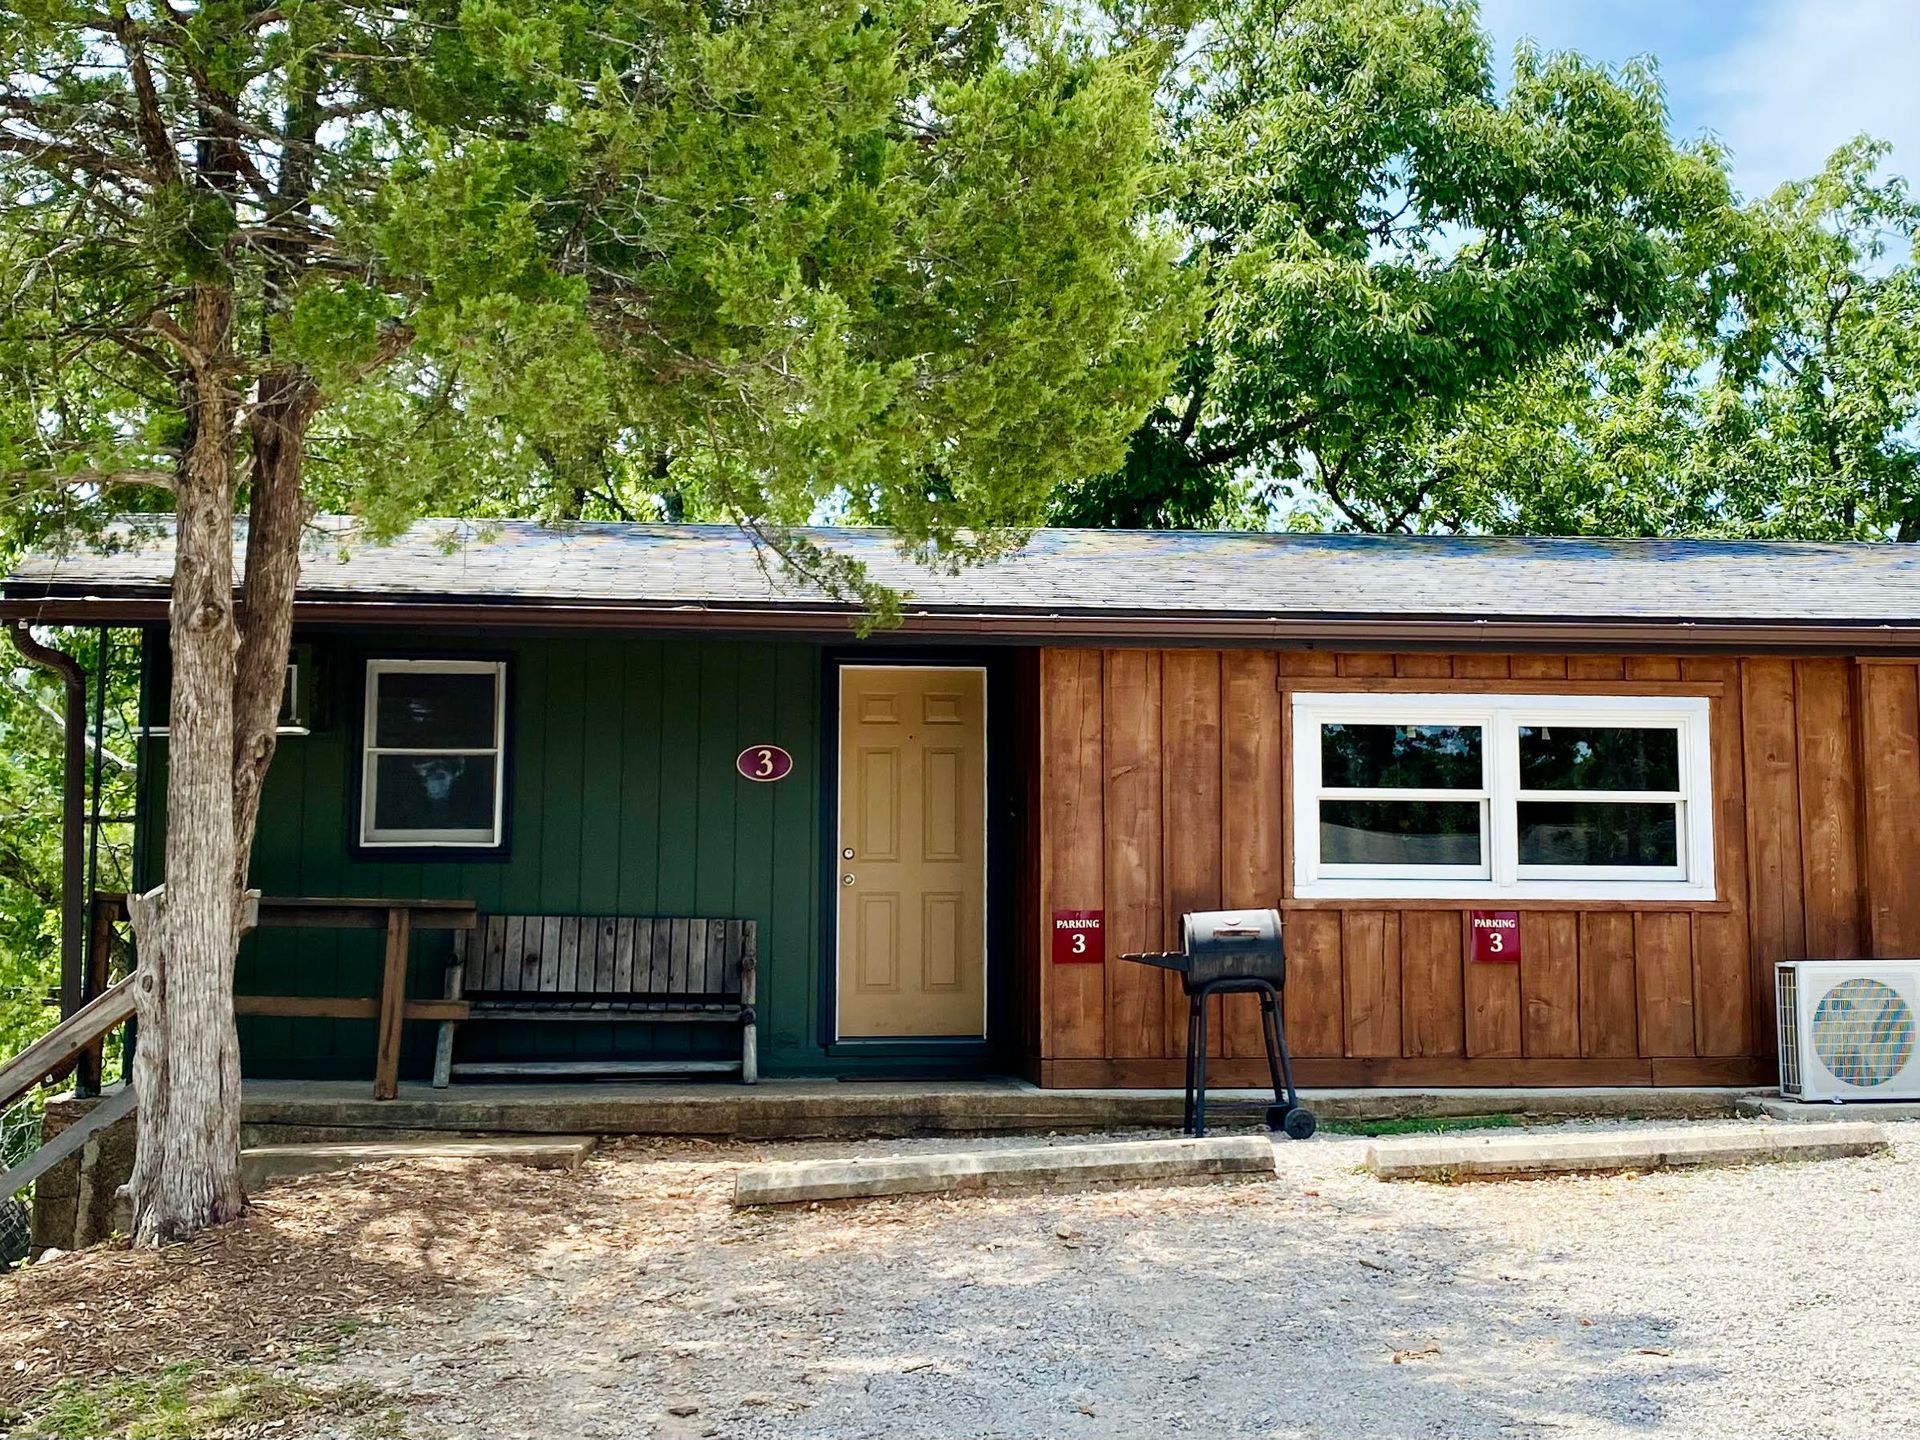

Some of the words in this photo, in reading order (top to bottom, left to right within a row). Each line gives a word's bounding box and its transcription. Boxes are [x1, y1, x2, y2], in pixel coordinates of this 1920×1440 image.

[756, 750, 773, 776] 3
[1056, 919, 1099, 929] PARKING
[1474, 918, 1516, 928] PARKING
[1072, 933, 1086, 953] 3
[1489, 932, 1503, 952] 3
